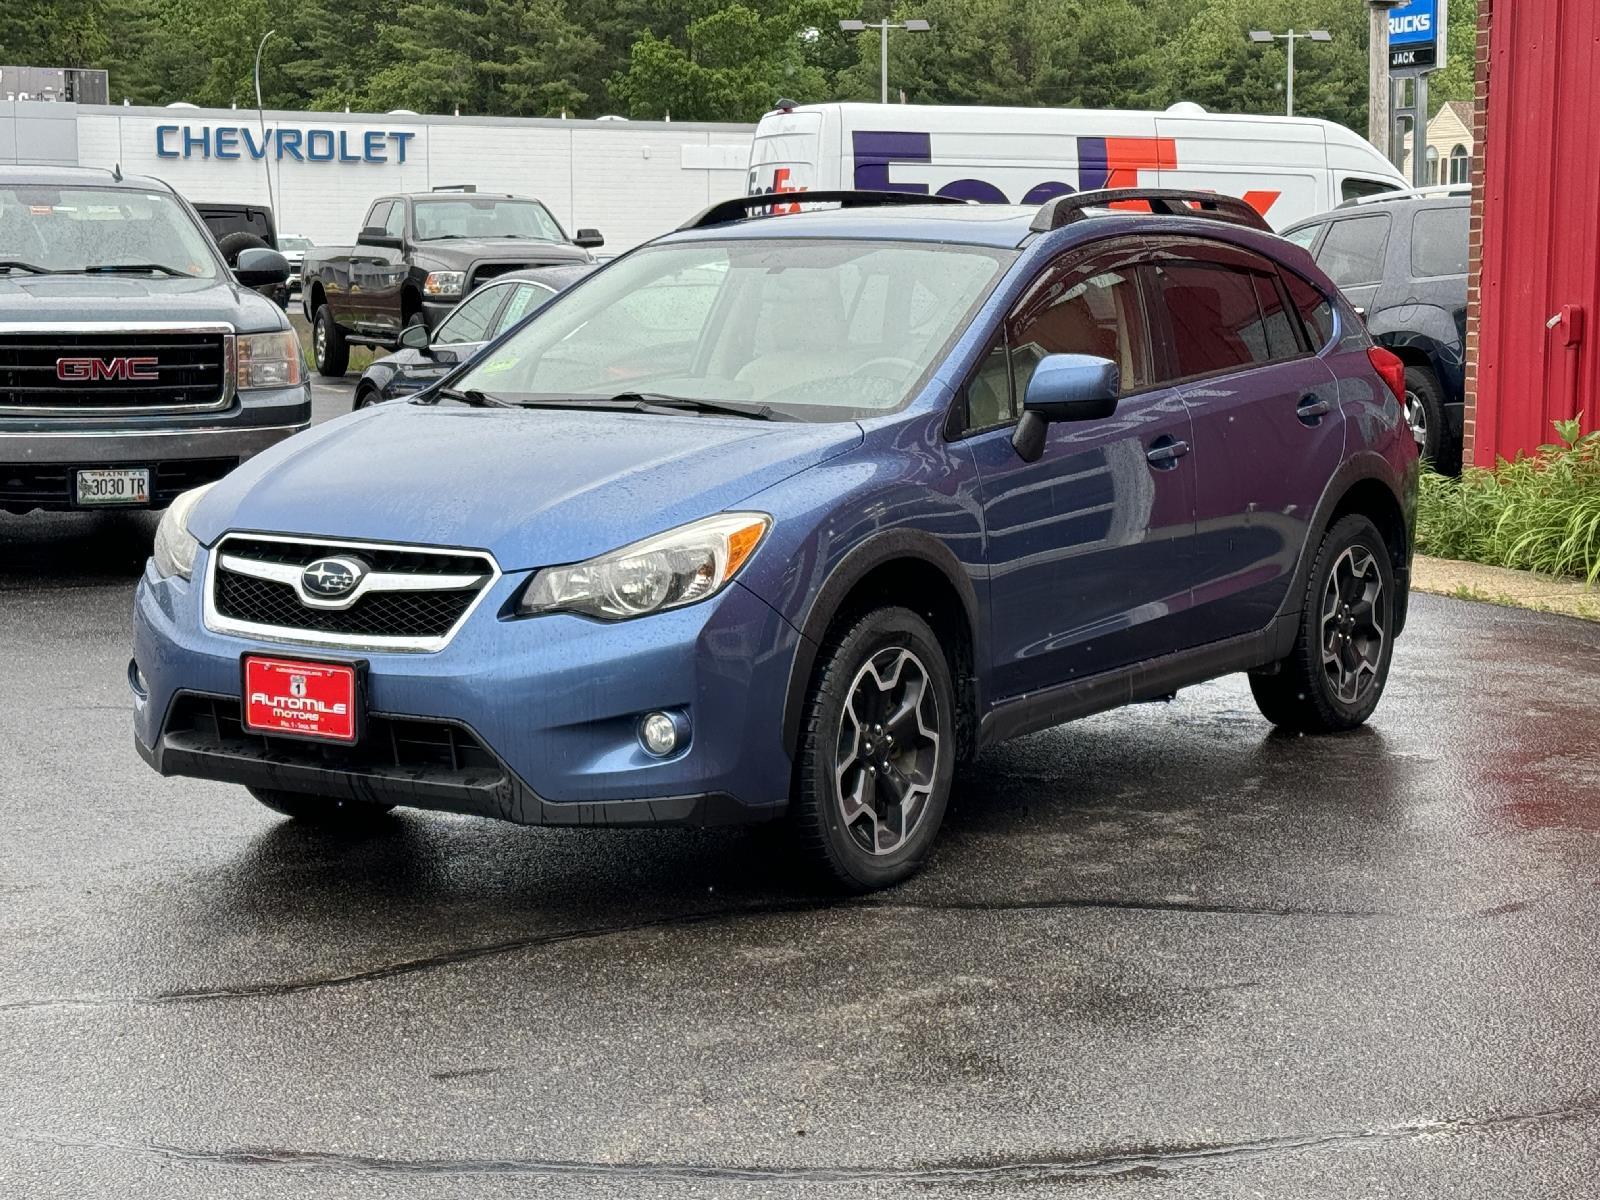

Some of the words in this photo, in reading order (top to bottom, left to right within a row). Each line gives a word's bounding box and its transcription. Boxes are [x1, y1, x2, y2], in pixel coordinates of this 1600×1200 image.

[1388, 14, 1430, 34] RUCKS
[1392, 51, 1415, 65] JACK
[156, 125, 416, 164] CHEVROLET
[852, 131, 1281, 216] FdE
[56, 357, 159, 380] GMC
[92, 478, 125, 495] 3030
[129, 478, 145, 495] TR
[251, 692, 347, 715] AUTOMILE
[273, 708, 319, 721] MOTORS
